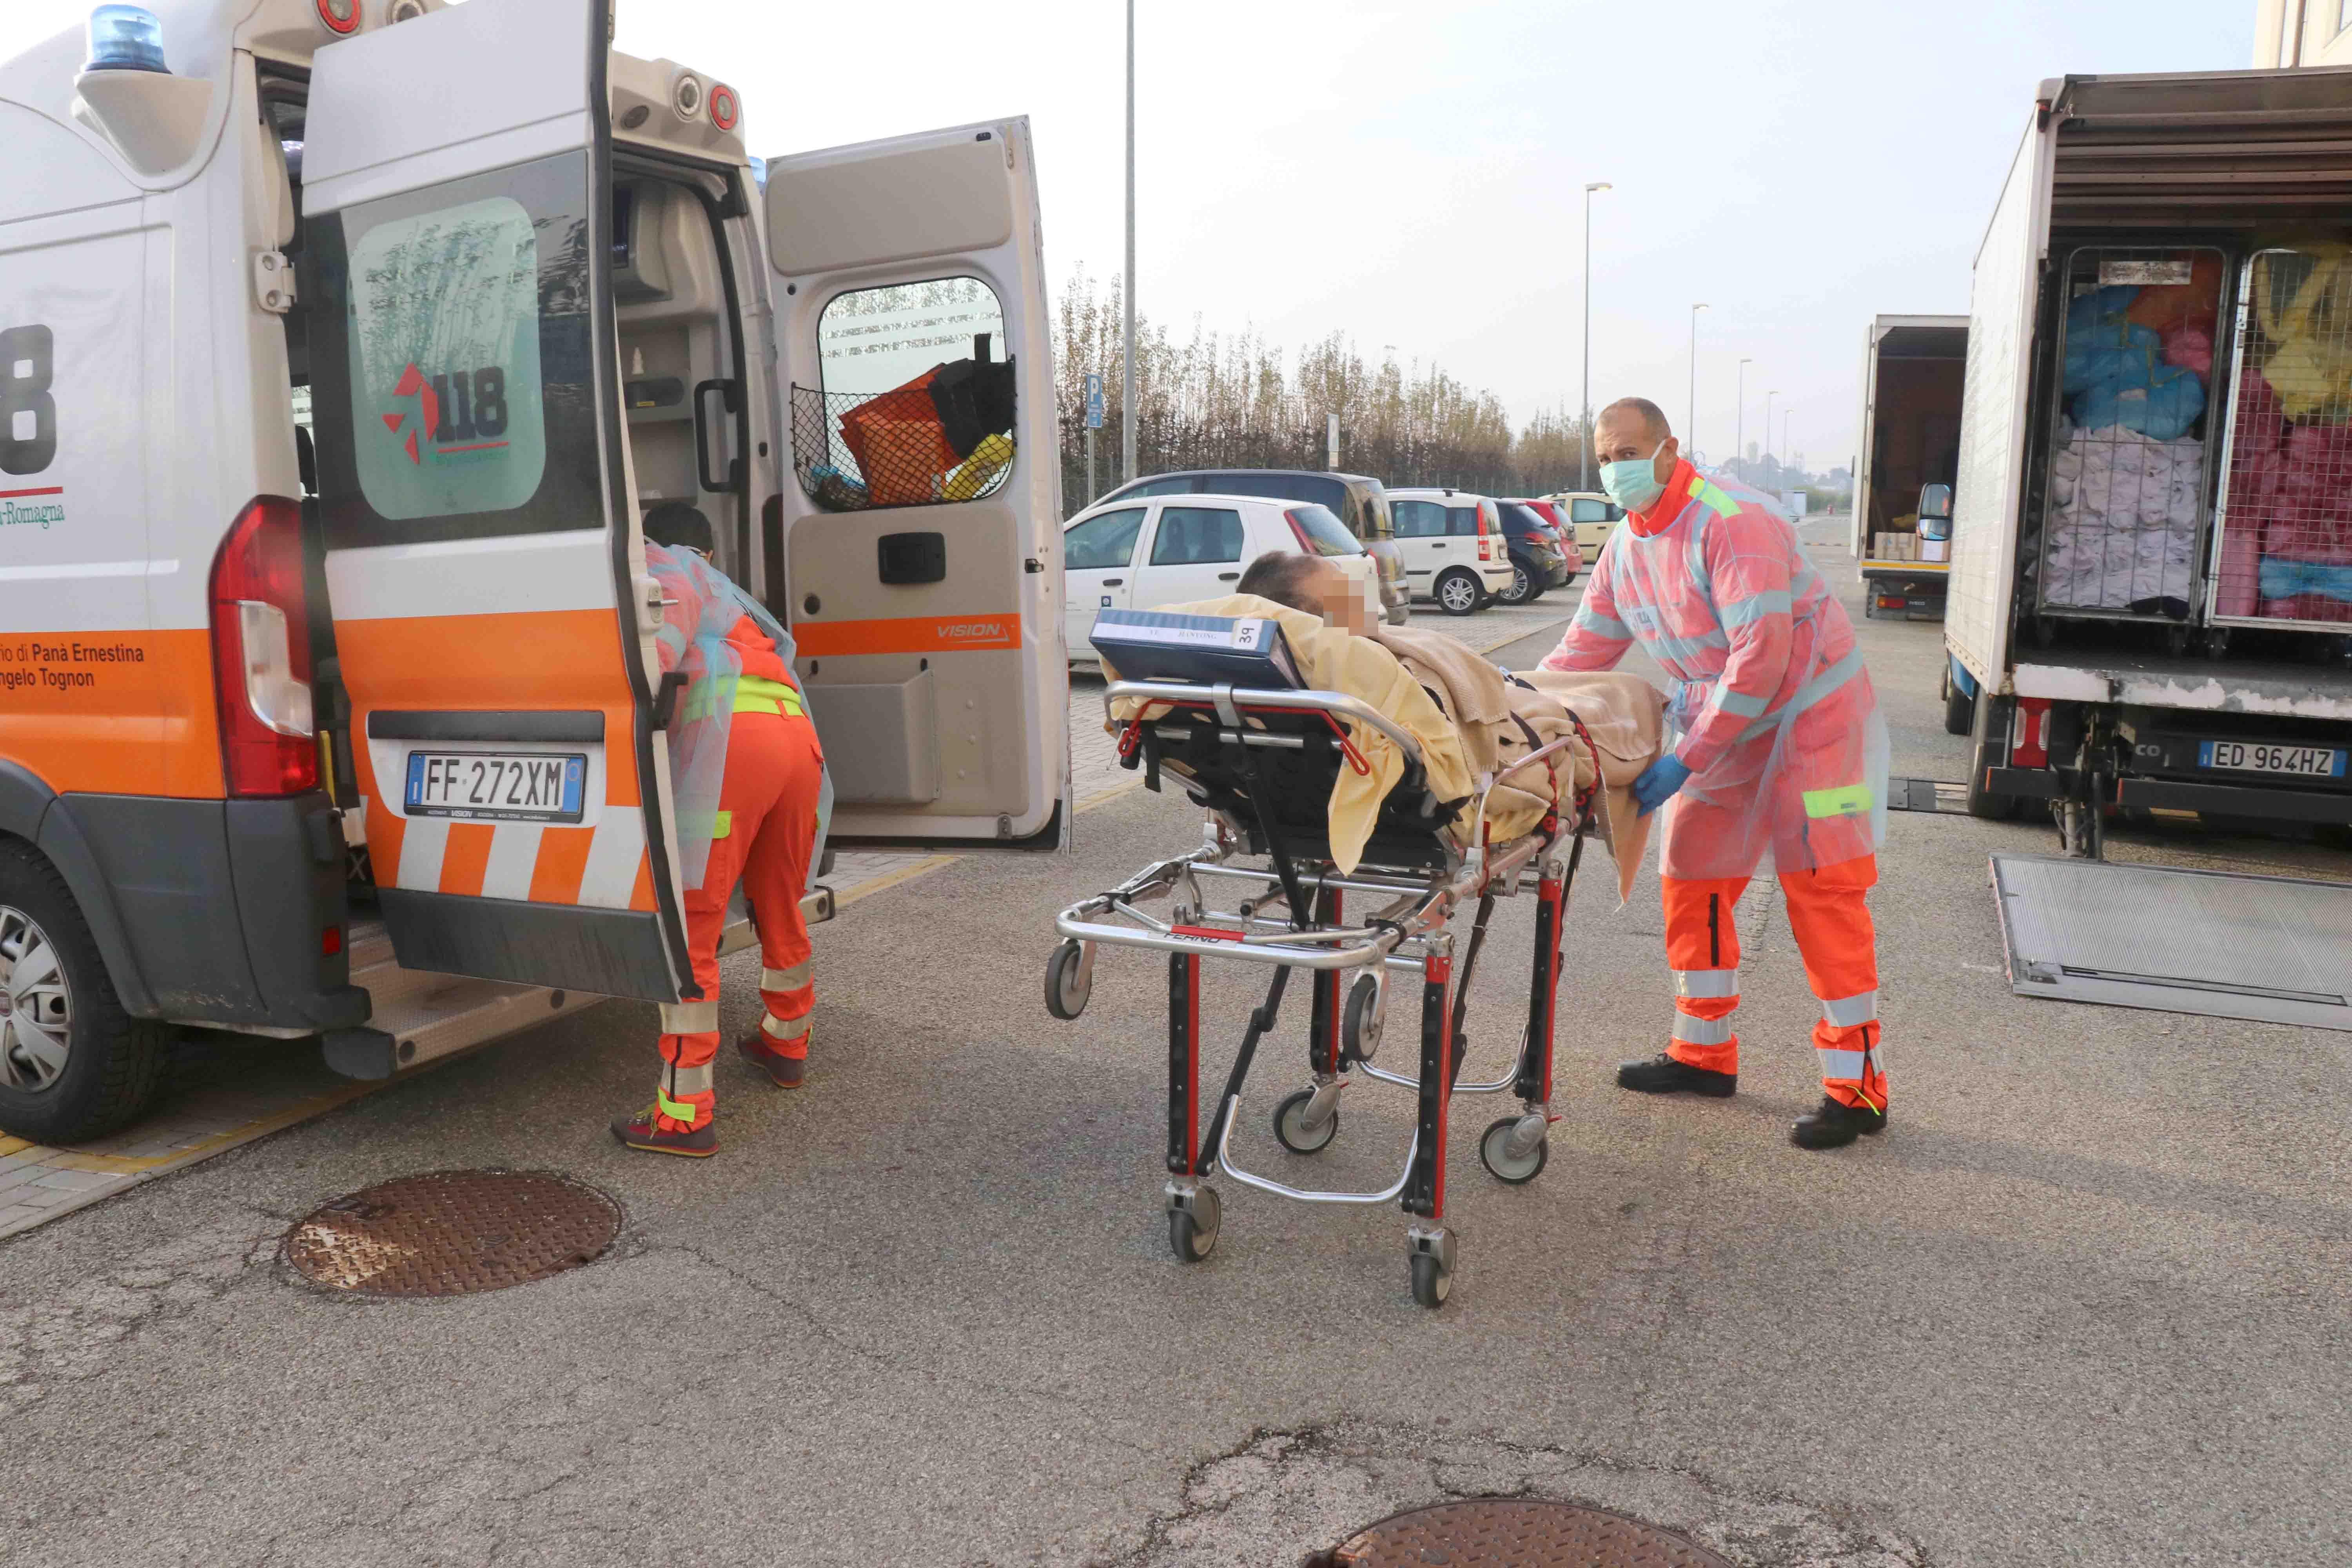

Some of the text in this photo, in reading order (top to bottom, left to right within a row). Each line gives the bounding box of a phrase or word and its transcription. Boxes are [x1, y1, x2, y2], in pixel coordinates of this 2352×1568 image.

[1091, 377, 1099, 402] P
[433, 366, 508, 442] 118
[937, 623, 1000, 637] VISION
[1239, 628, 1255, 643] 39
[16, 644, 29, 662] di
[32, 643, 69, 662] Panà
[72, 643, 144, 662] Ernestina
[0, 668, 94, 691] ngelo Tognon
[2215, 744, 2244, 767] ED
[2254, 747, 2331, 774] 964HZ
[426, 759, 459, 801] FF
[470, 761, 561, 806] 272XM
